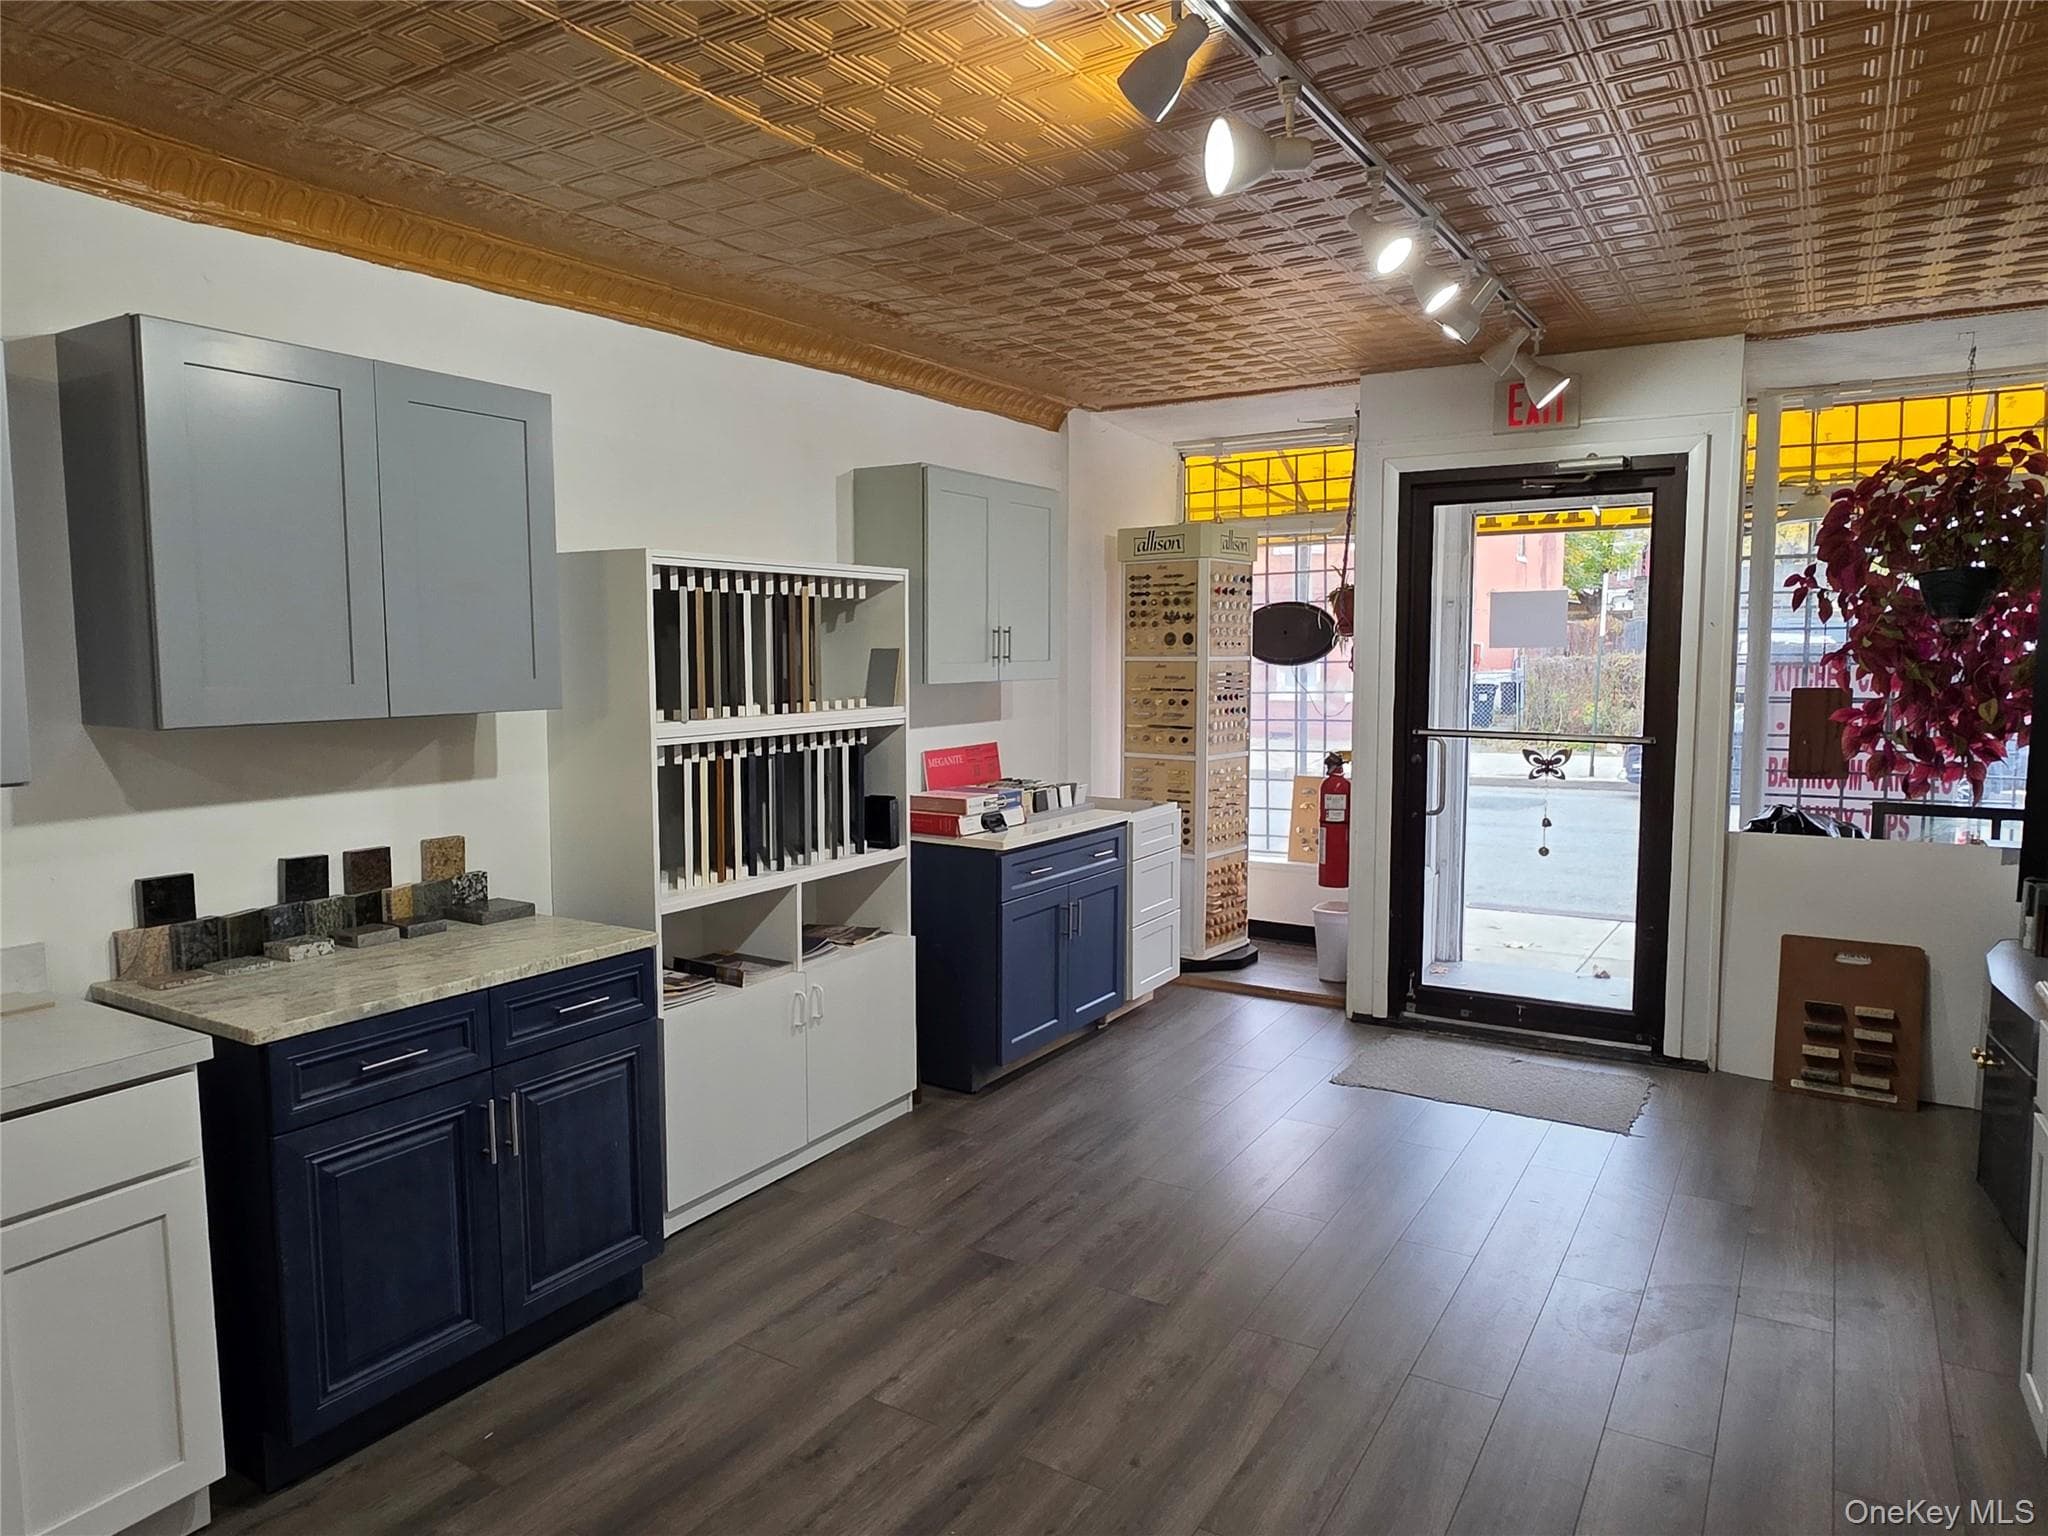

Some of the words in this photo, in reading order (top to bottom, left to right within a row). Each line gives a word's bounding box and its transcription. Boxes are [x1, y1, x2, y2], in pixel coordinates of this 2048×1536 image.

[1136, 530, 1181, 553] allison
[1775, 662, 1842, 692] KITCHE
[1863, 808, 1910, 841] TPS
